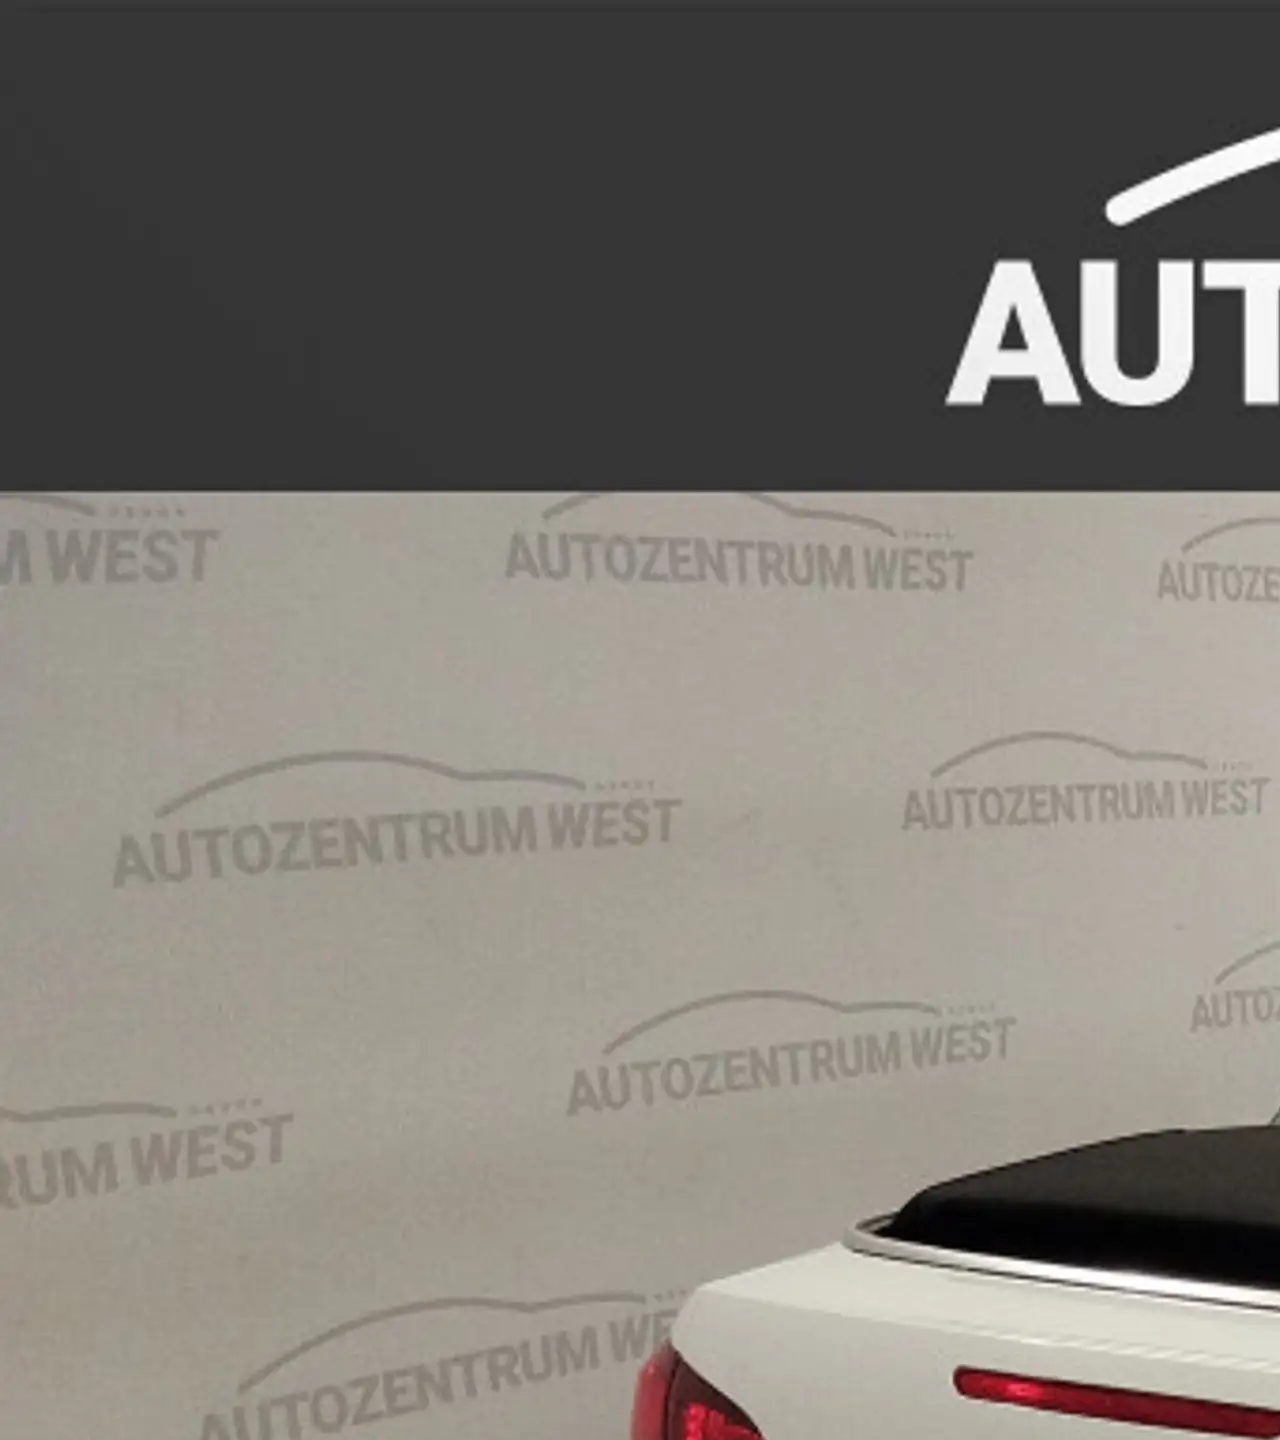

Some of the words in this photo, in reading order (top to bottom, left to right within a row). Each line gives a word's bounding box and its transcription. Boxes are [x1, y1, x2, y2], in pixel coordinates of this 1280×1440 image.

[46, 529, 220, 583] WEST
[505, 530, 855, 590] AUTOZENTRUM
[864, 546, 974, 592] WEST
[901, 781, 1175, 831] AUTOZENTRUM
[1182, 777, 1271, 818] WEST
[113, 806, 537, 888] AUTOZENTRUM
[547, 798, 682, 848] WEST
[567, 1029, 900, 1116] AUTOZENTRUM
[910, 1017, 1017, 1071] WEST
[130, 1112, 294, 1187] WEST
